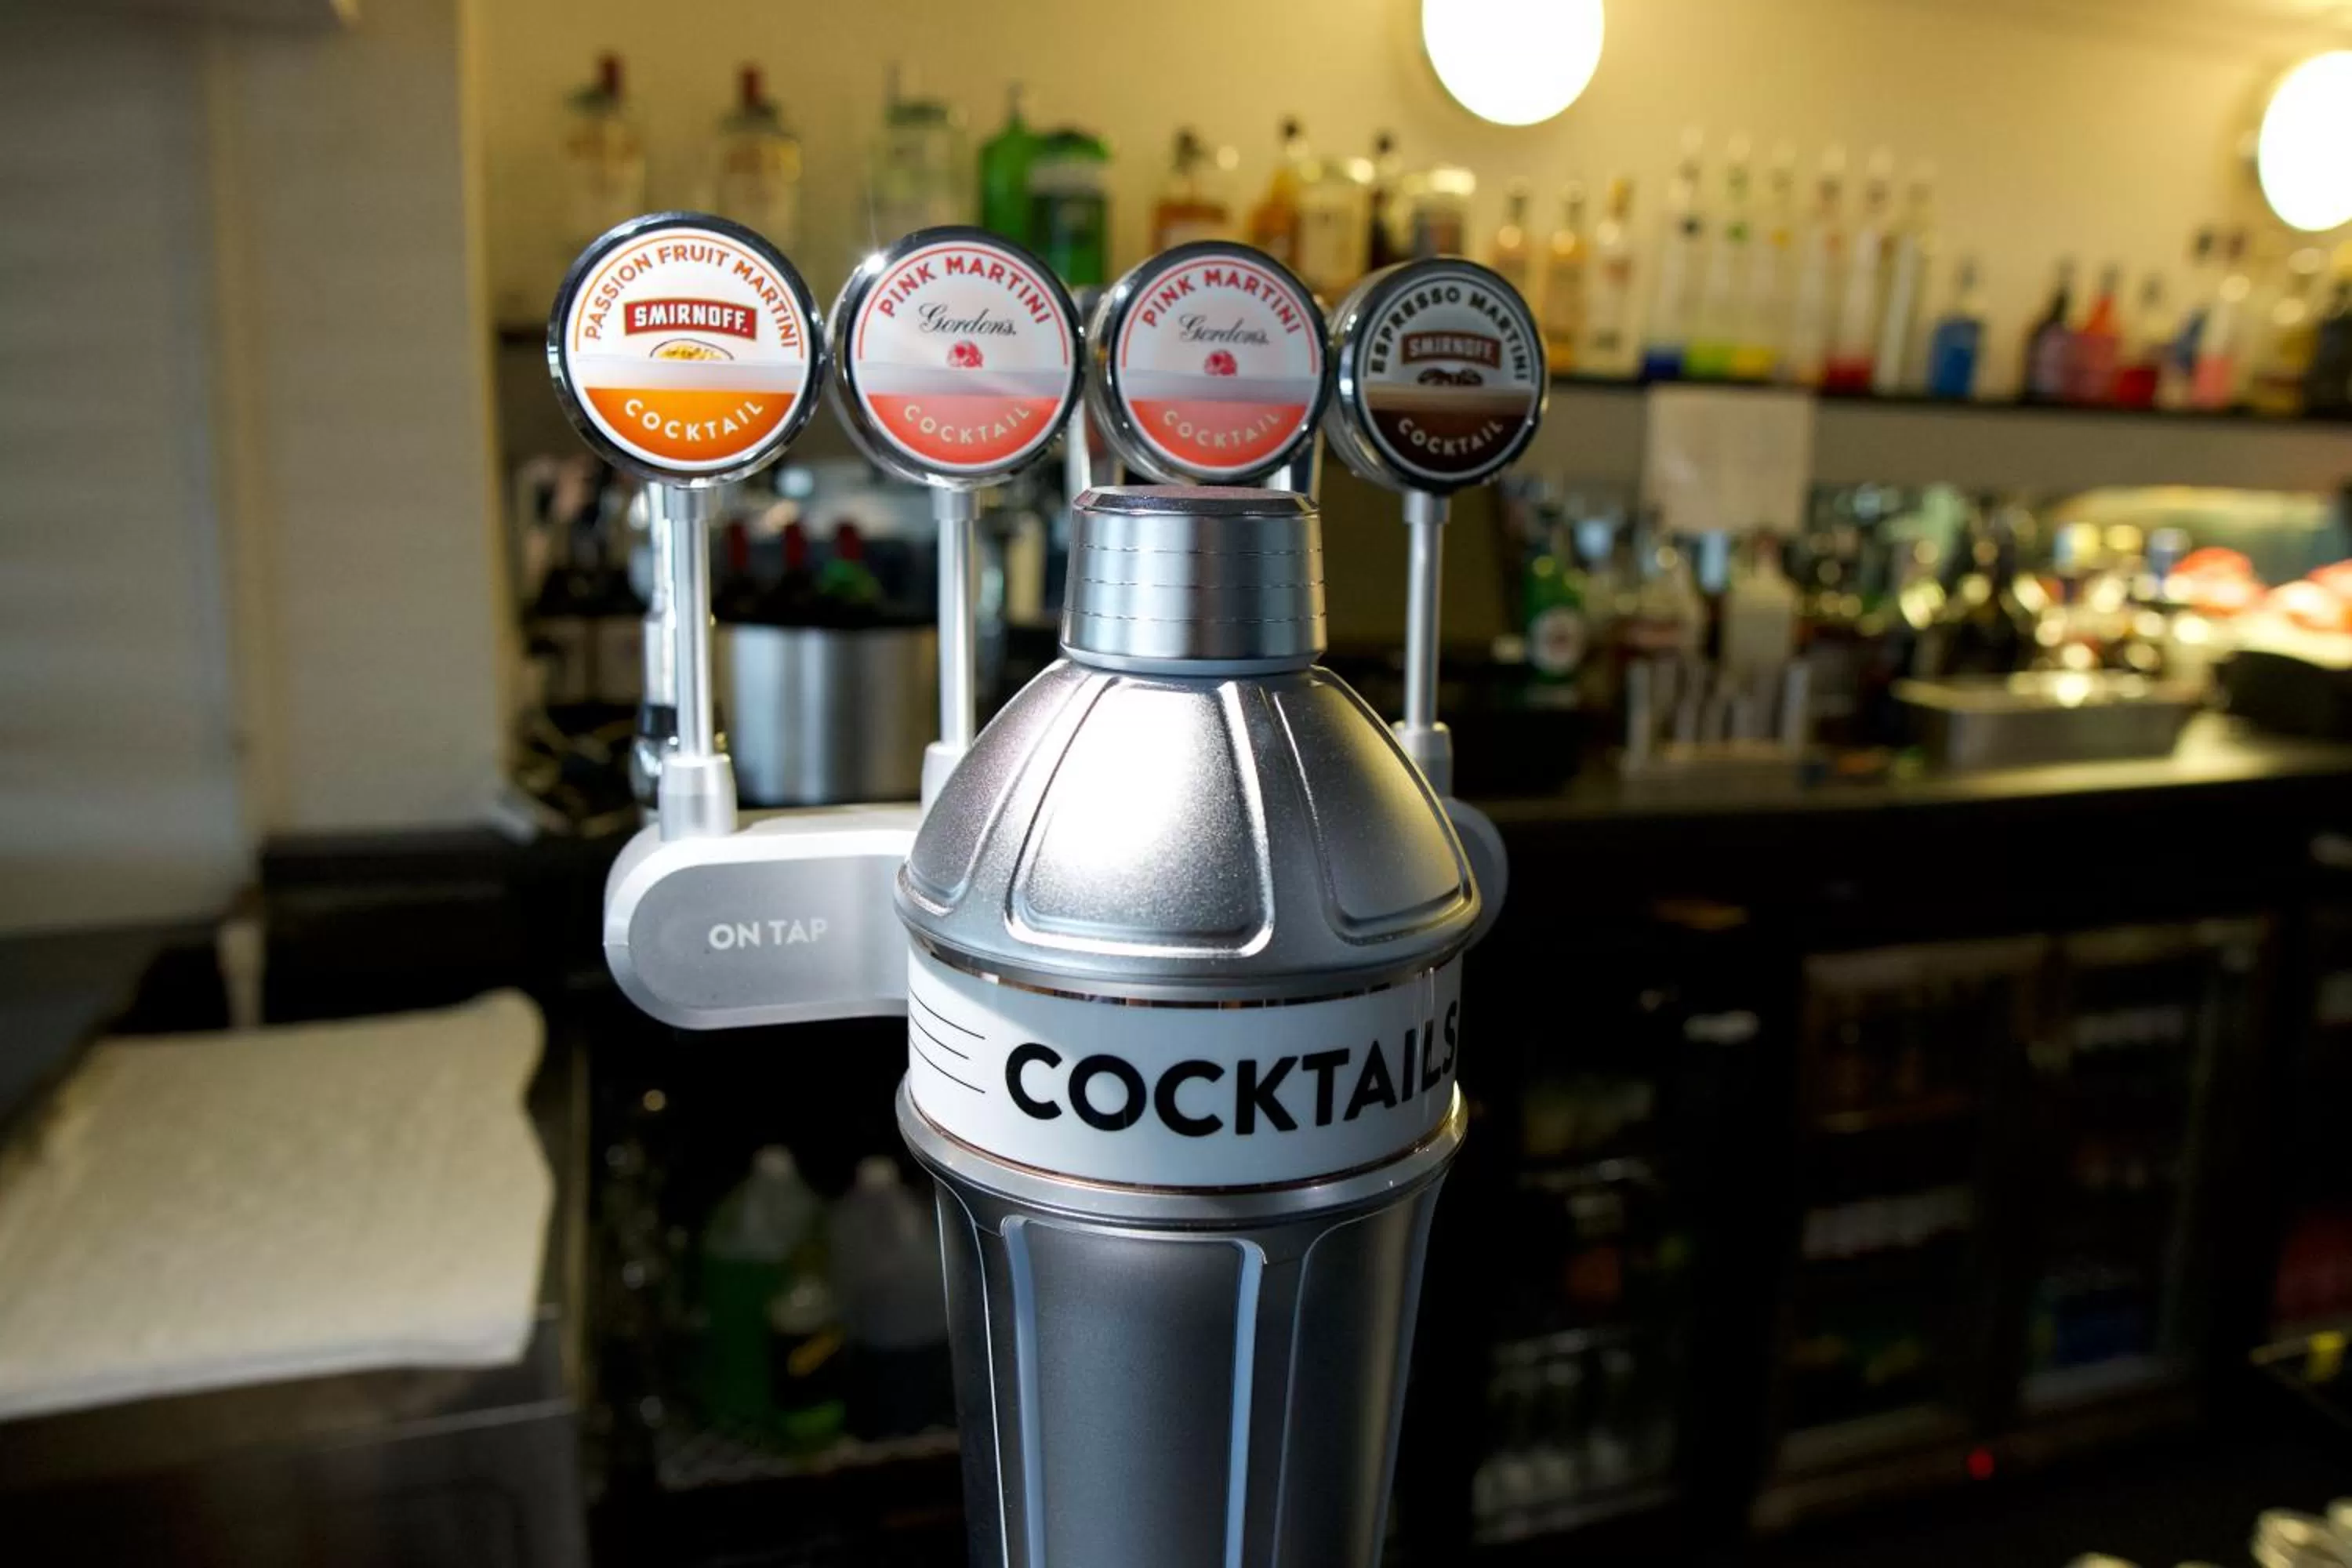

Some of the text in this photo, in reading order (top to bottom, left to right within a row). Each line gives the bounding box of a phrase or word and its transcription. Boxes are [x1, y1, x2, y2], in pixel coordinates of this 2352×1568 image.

[584, 244, 798, 348] PASSION FRUIT MARTINI
[878, 256, 1051, 325] PINK MARTINI
[1142, 269, 1302, 334] PINK MARTINI
[1371, 287, 1528, 380] ESPRESSO MARTINI
[624, 398, 764, 442] COCKTAIL
[903, 404, 1031, 445] COCKTAIL
[1163, 409, 1281, 449] COCKTAIL
[1398, 416, 1504, 456] COCKTAIL
[708, 916, 829, 950] ON TAP
[1004, 1000, 1458, 1138] COCKTAILS
